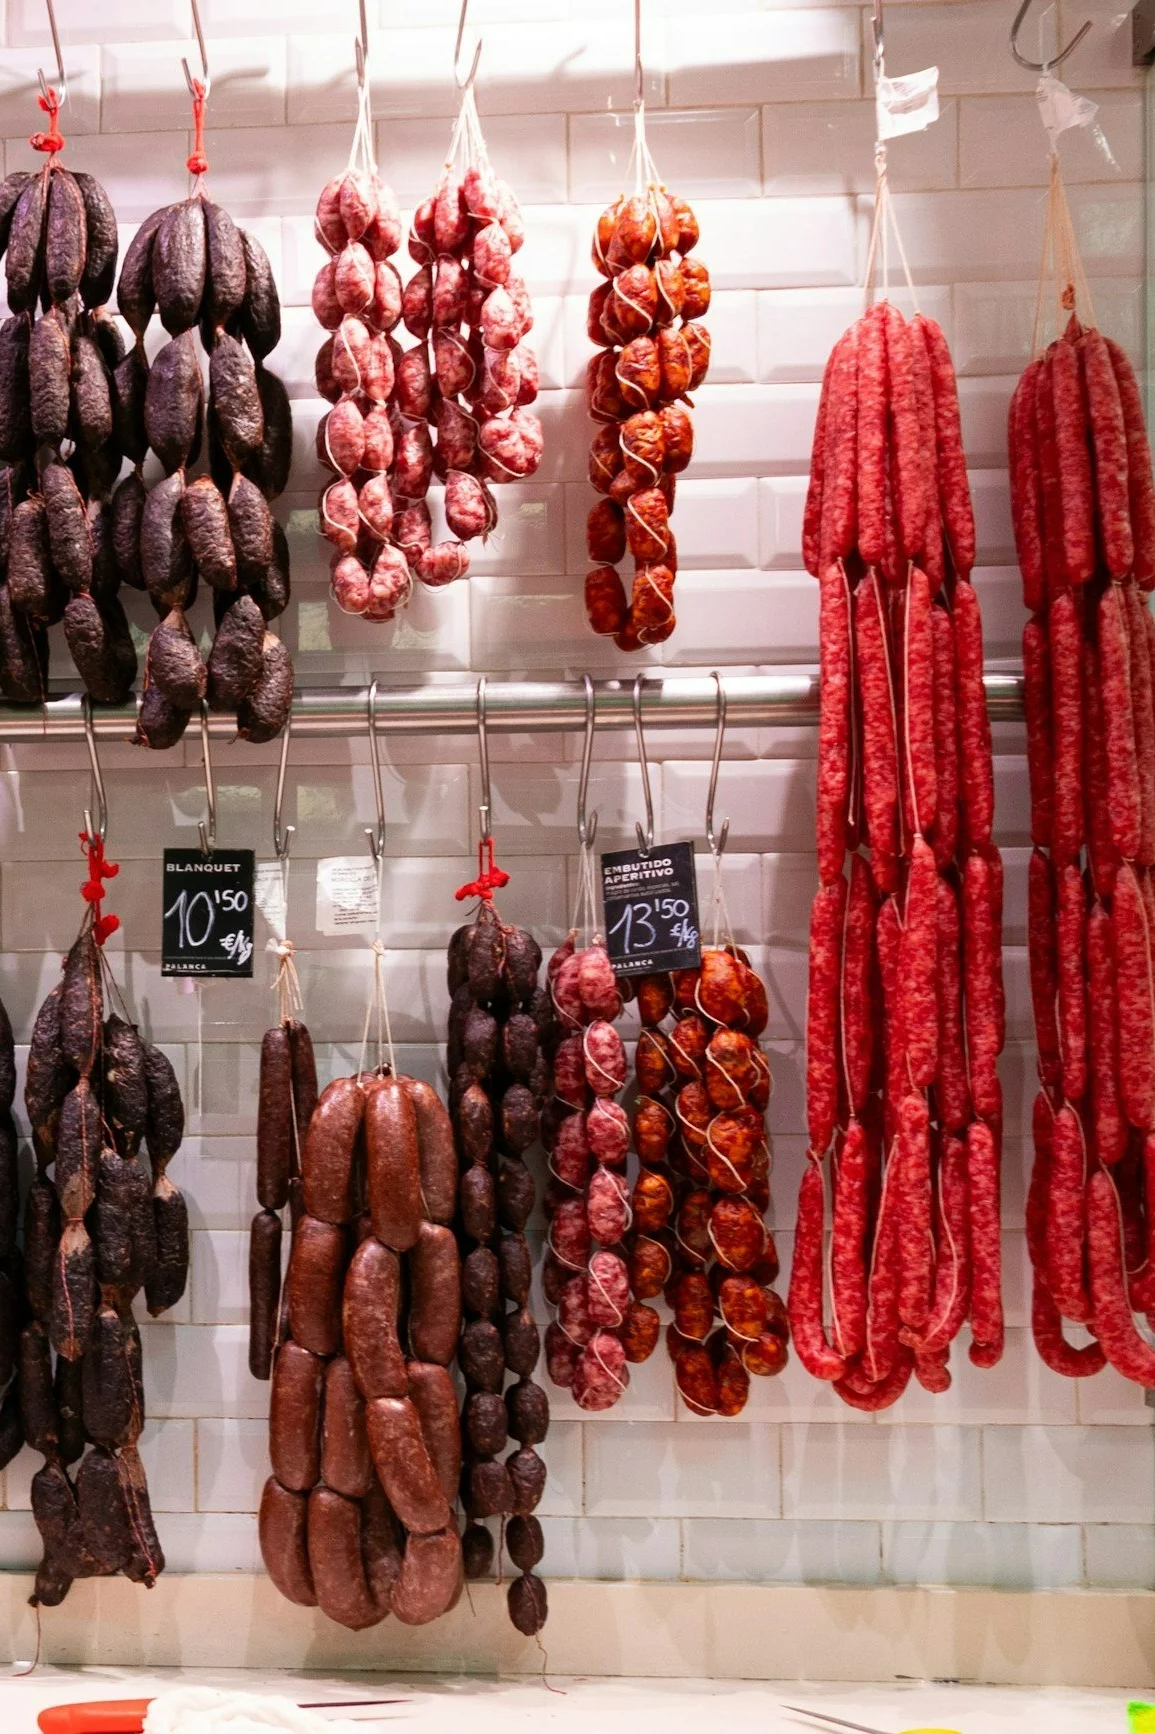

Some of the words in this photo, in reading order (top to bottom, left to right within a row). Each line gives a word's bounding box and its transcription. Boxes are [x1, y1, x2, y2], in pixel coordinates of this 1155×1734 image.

[166, 863, 241, 872] BLANQUET
[604, 858, 672, 875] EMBUTIDO
[604, 867, 674, 885] APERITIVO
[612, 959, 654, 969] PALANCA
